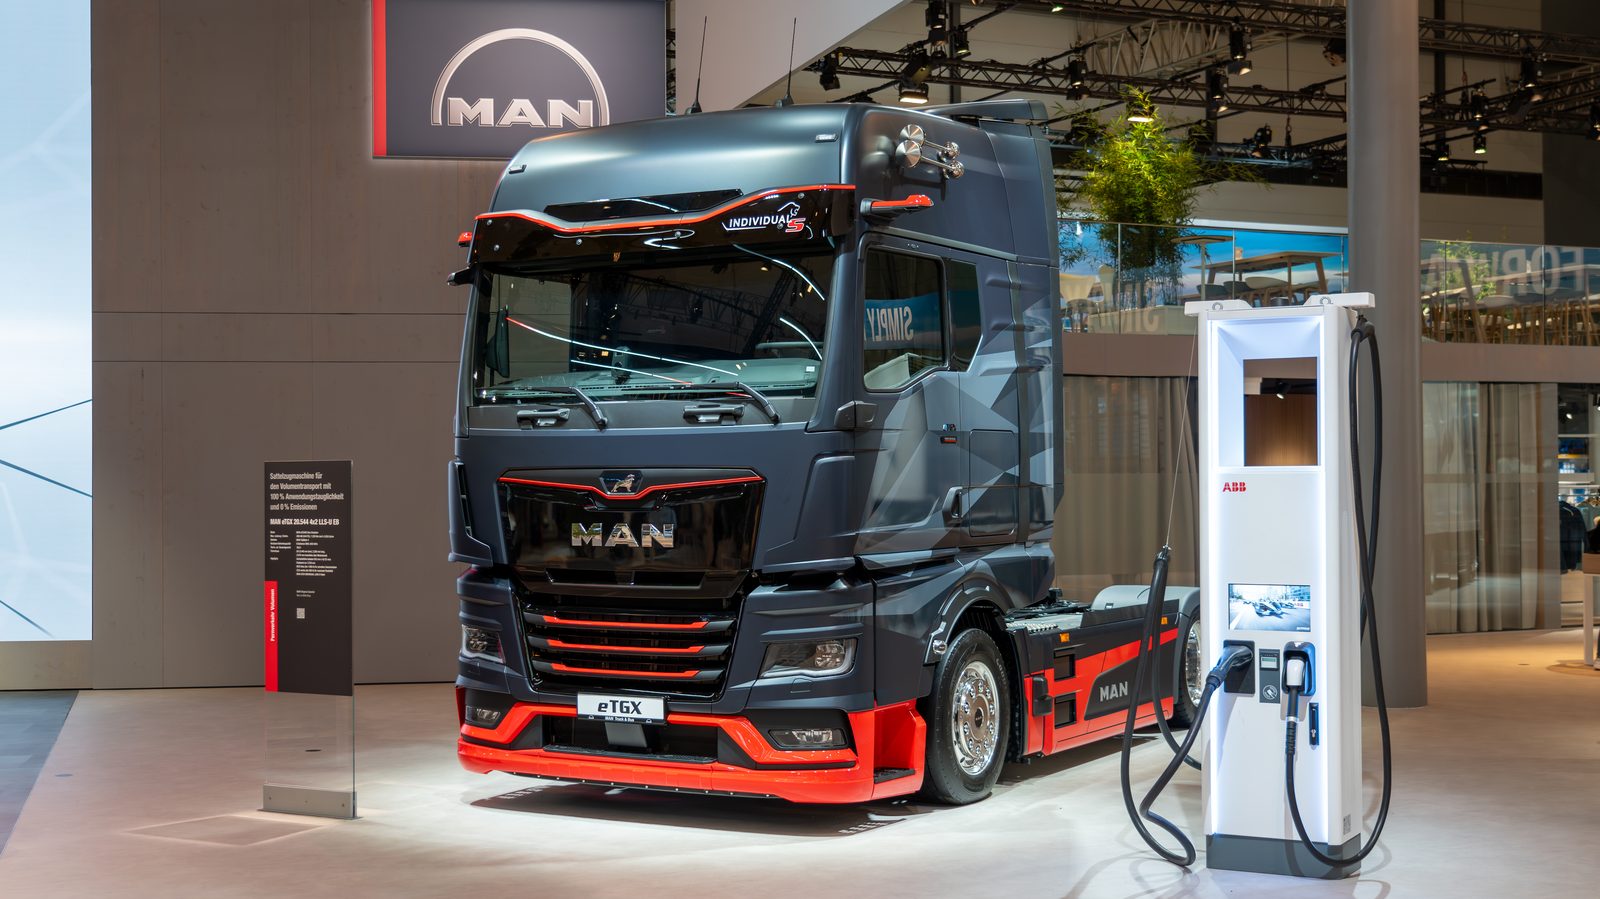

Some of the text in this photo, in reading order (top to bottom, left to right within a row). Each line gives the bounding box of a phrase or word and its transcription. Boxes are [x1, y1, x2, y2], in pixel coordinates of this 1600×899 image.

[448, 98, 593, 128] MAN
[729, 214, 793, 228] INDIVIDUAL
[269, 472, 323, 481] Sattelzugmaschine für
[280, 483, 322, 491] Volumentransport
[323, 482, 332, 490] mit
[1222, 481, 1247, 492] ABB
[285, 493, 344, 501] Anwendungstauglichkeit
[269, 503, 280, 511] und
[290, 503, 318, 511] Emissionen
[269, 518, 280, 526] MAN
[281, 518, 293, 526] eTGX
[310, 518, 318, 526] 4x2
[571, 522, 674, 548] MAN
[1100, 681, 1128, 702] MAN
[597, 699, 642, 714] eTGX
